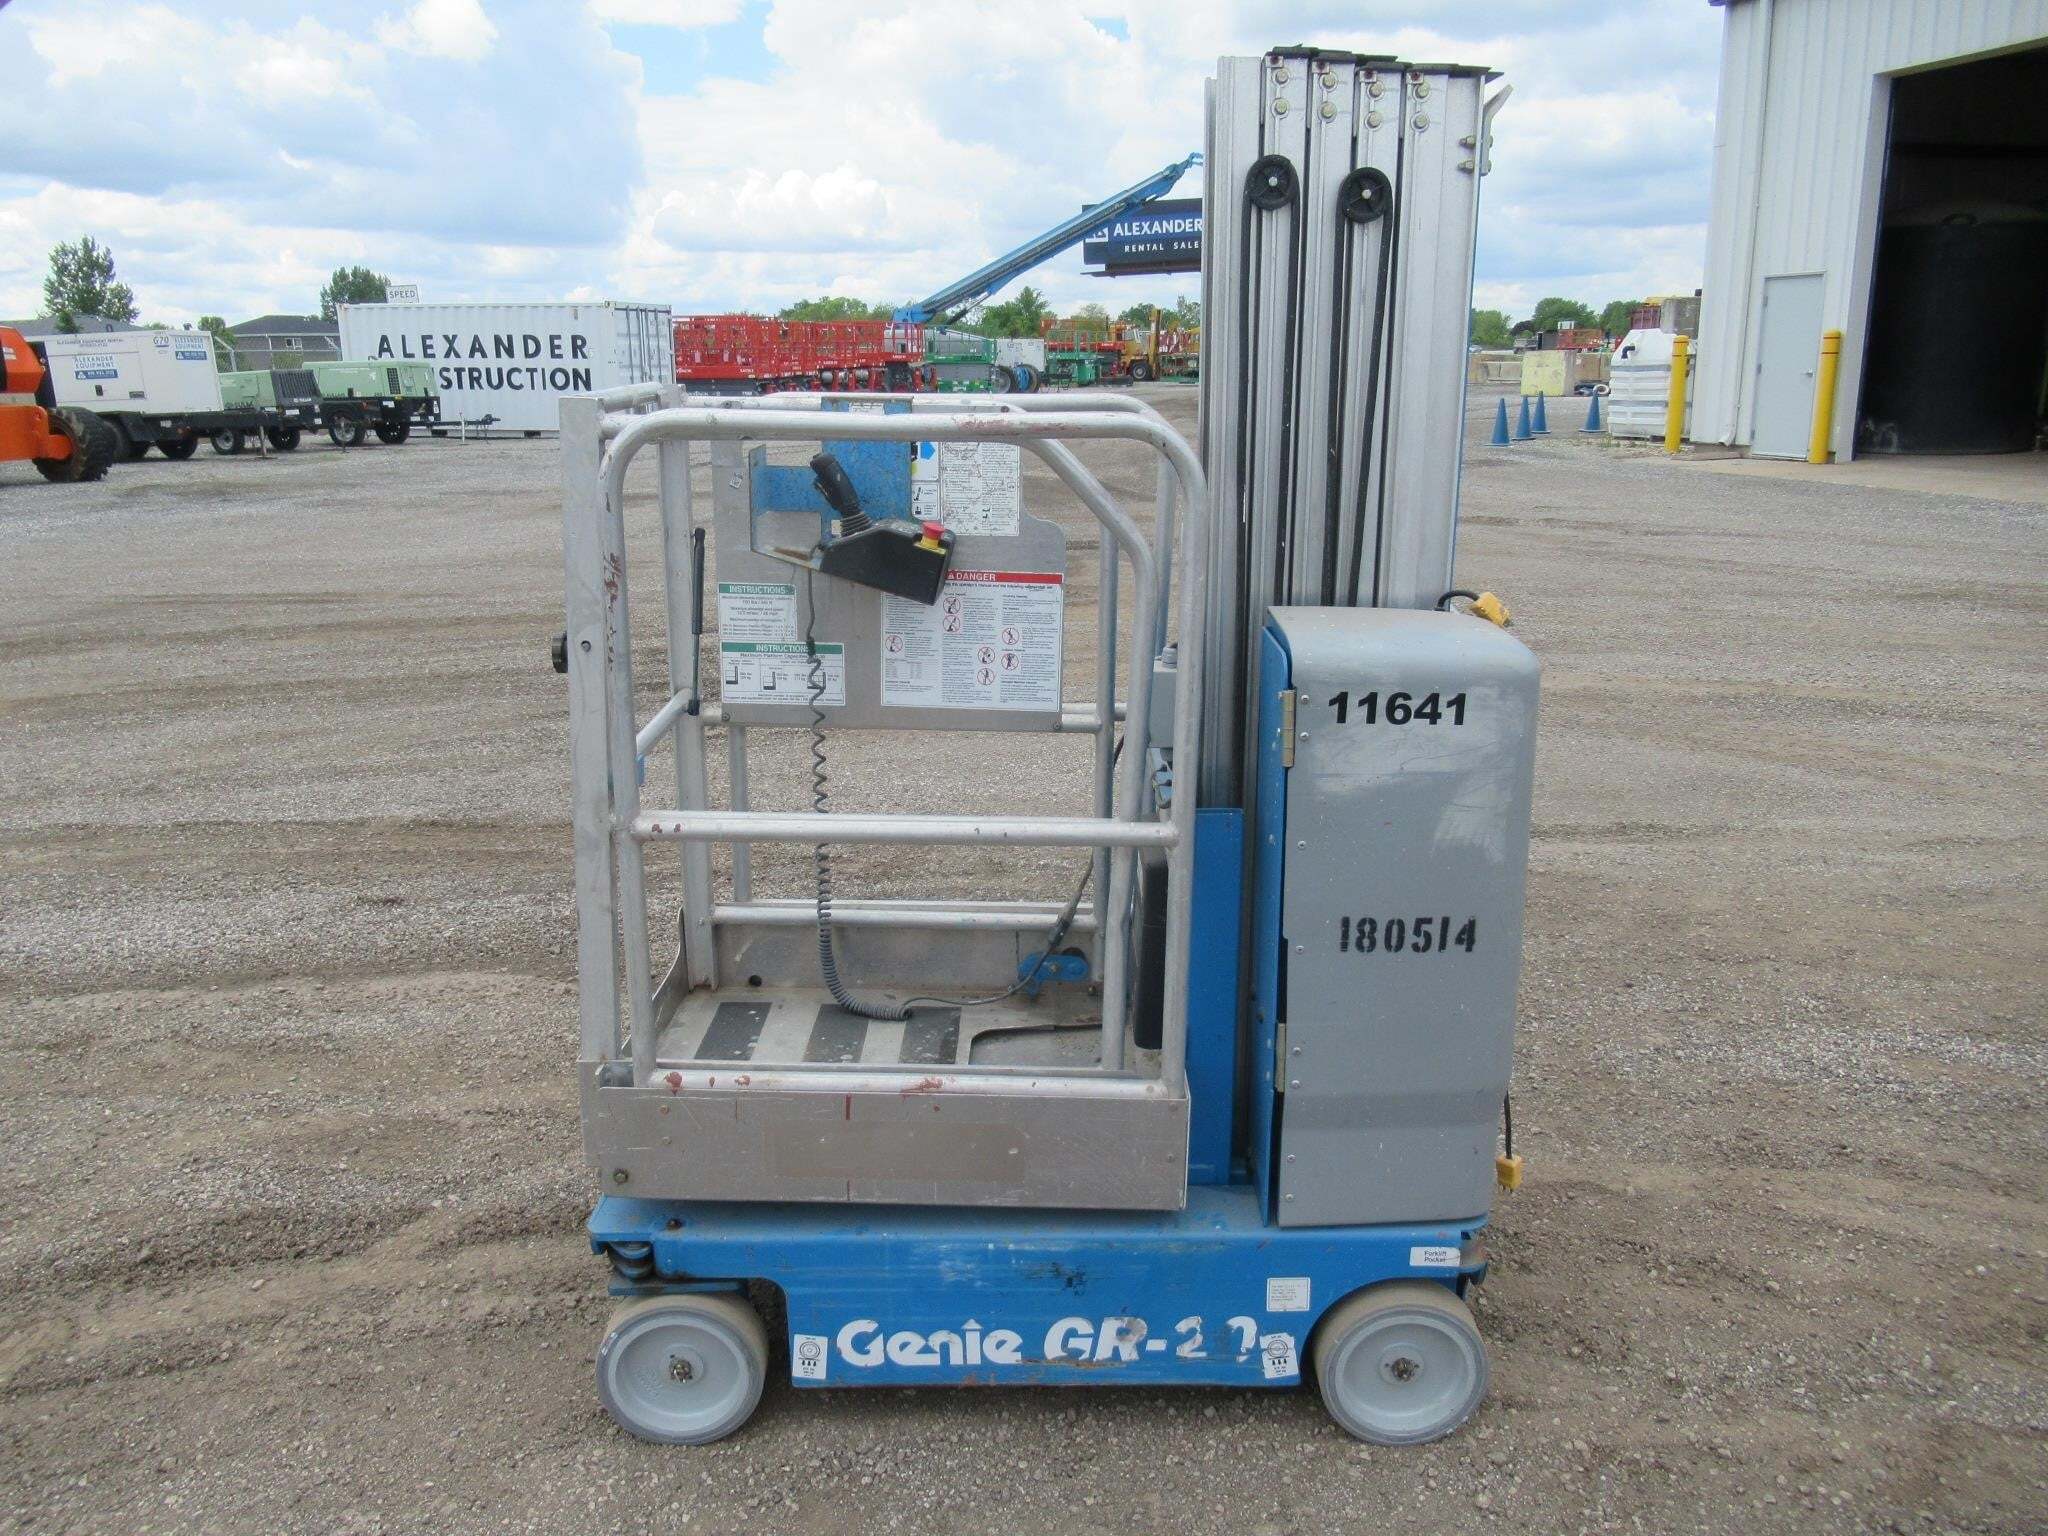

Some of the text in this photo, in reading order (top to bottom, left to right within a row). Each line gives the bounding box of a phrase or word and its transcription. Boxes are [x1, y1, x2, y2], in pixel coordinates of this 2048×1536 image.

[1113, 219, 1202, 237] ALEXANDER
[1124, 240, 1203, 252] RENTAL SALE
[389, 290, 416, 299] SPEED
[378, 334, 588, 360] ALEXANDER
[433, 366, 592, 392] STRUCTION
[956, 572, 996, 582] DANGER
[729, 585, 786, 594] INSTRUCTIONS
[1328, 691, 1466, 726] 11641
[1340, 916, 1477, 953] 180514
[837, 1318, 1023, 1367] Genie
